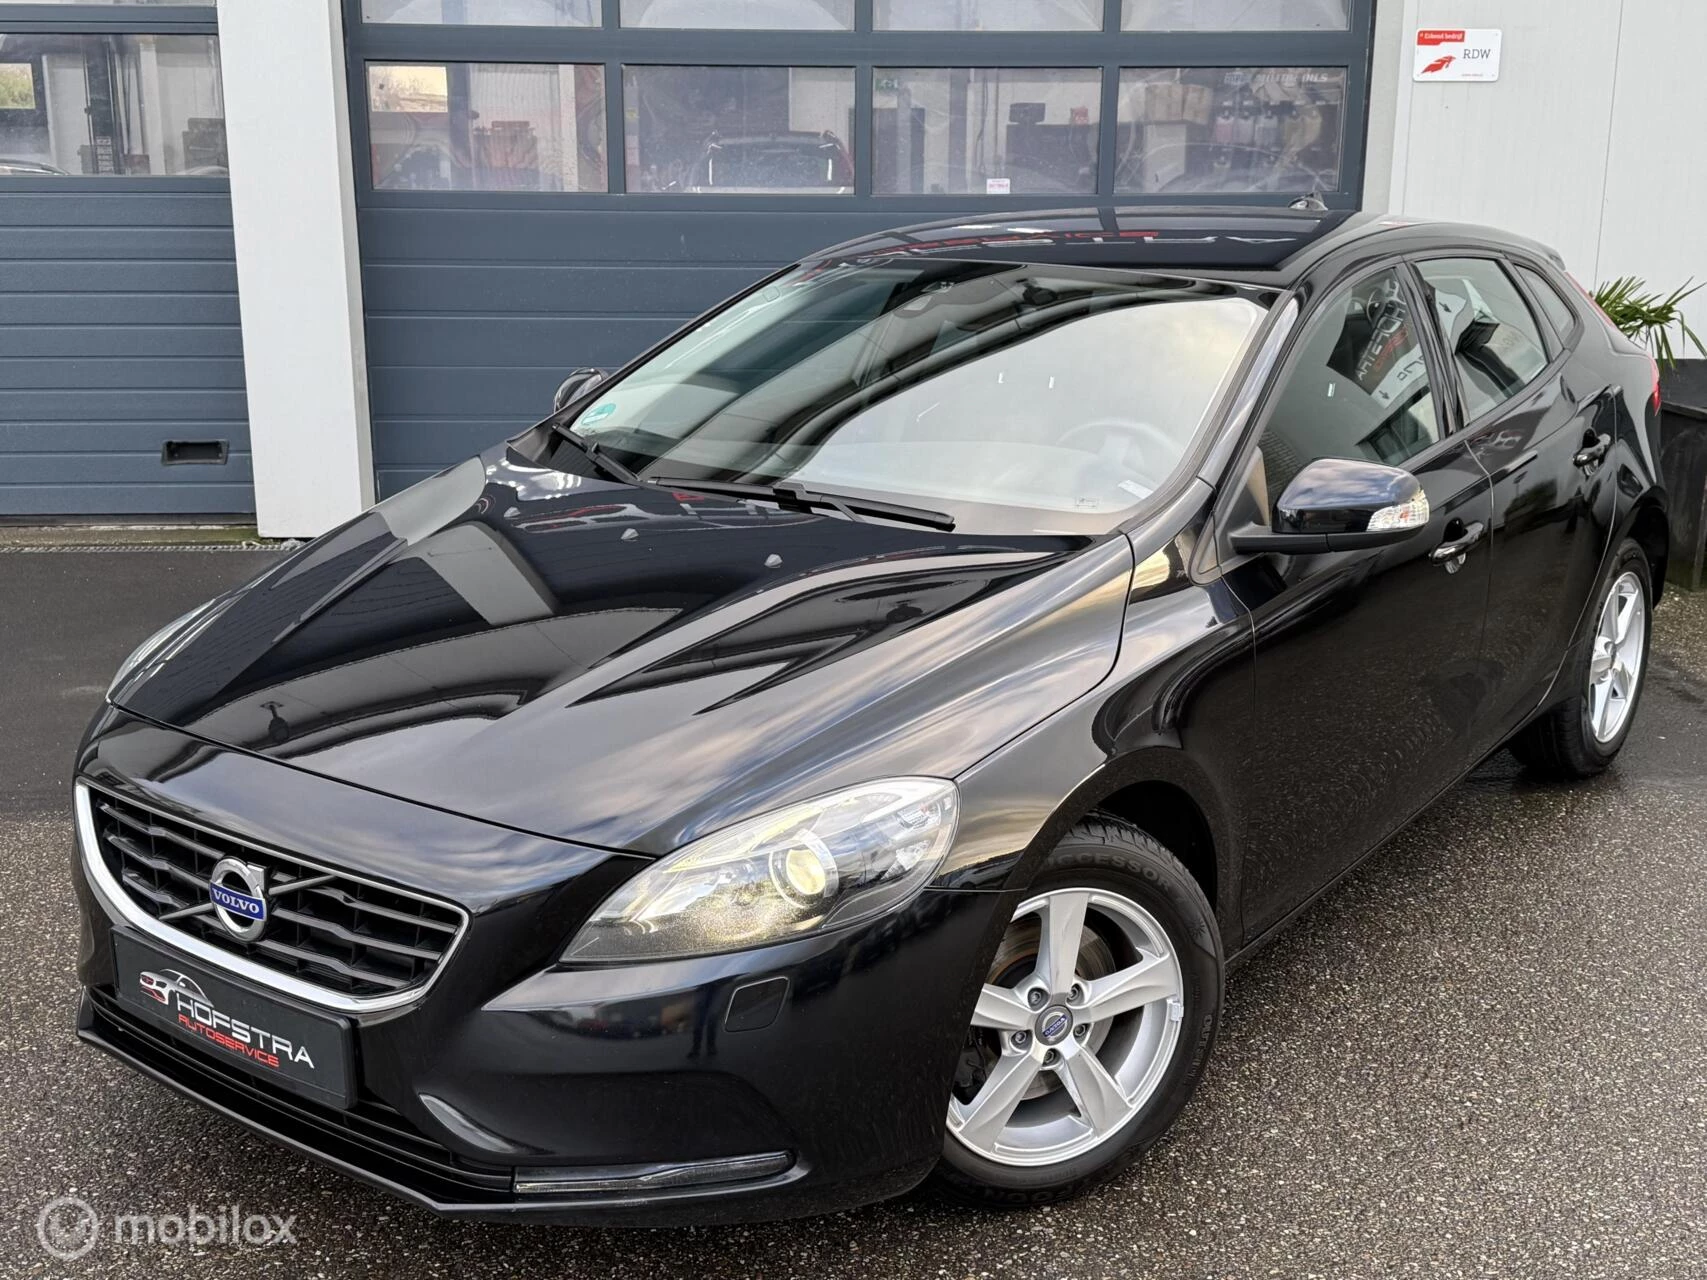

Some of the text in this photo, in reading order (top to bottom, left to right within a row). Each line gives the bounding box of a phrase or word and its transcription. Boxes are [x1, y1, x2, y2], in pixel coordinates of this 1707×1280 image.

[1463, 48, 1491, 59] RDW
[1046, 852, 1171, 892] CCESSOR
[212, 889, 260, 914] VOLVO
[176, 990, 315, 1069] HOFSTRA
[178, 1013, 280, 1068] AUTOSERVICE
